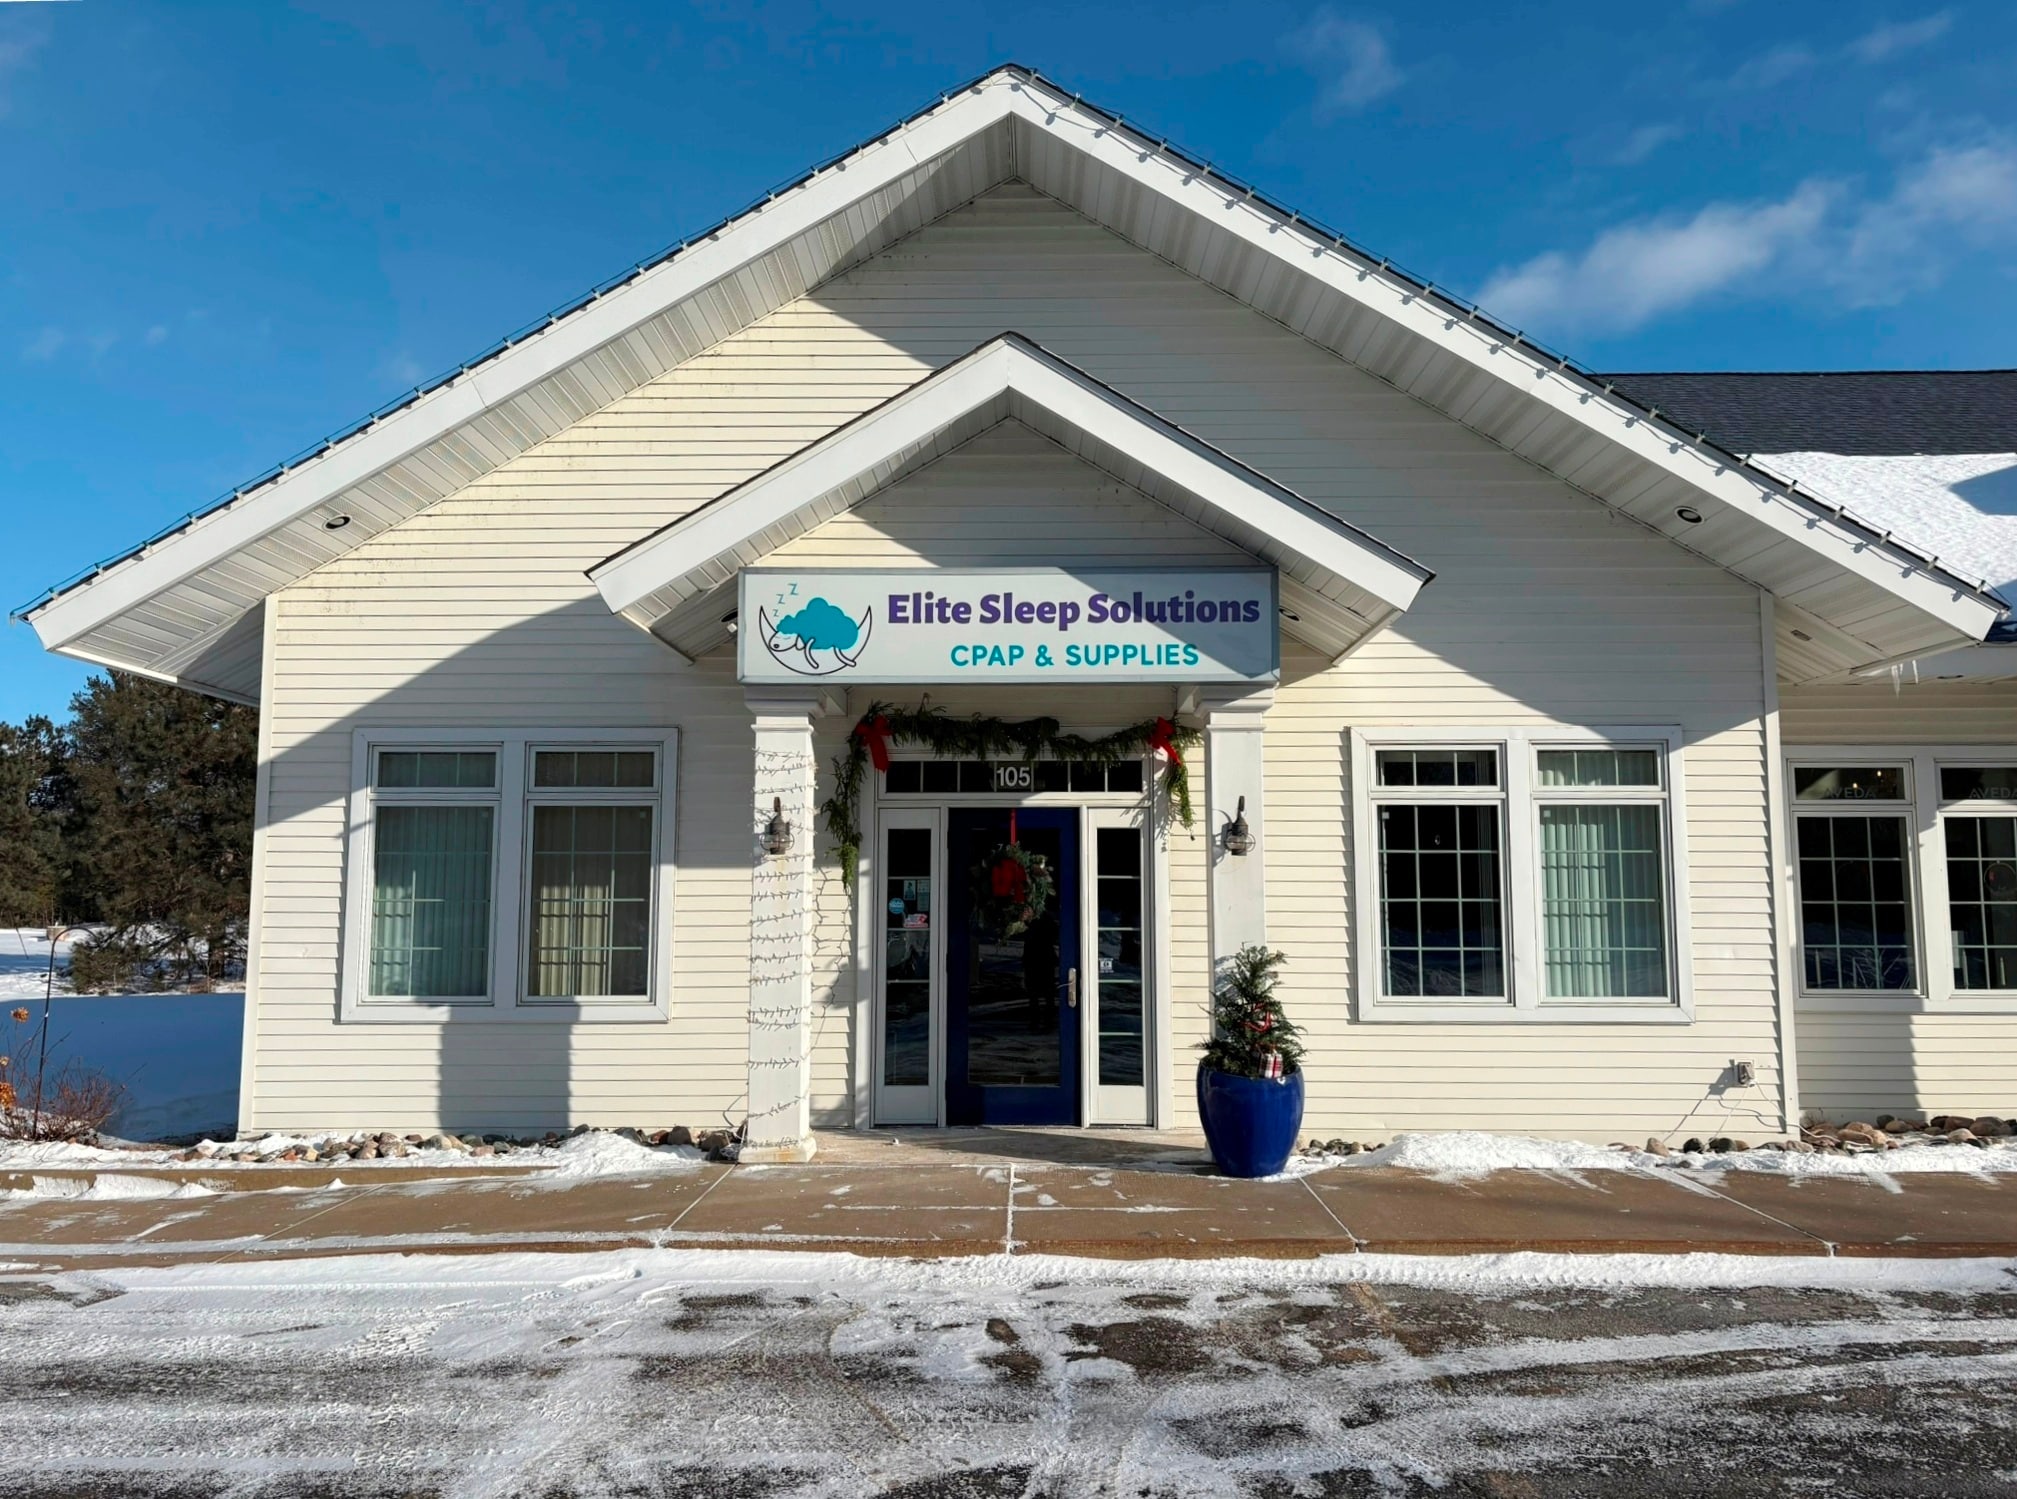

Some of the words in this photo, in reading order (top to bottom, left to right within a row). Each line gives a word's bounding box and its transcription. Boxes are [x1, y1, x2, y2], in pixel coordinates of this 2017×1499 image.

[888, 592, 971, 623] Elite
[980, 592, 1080, 631] Sleep
[1087, 590, 1260, 623] Solutions
[951, 645, 1024, 667] CPAP
[1035, 645, 1054, 667] &
[1066, 644, 1199, 666] SUPPLIES
[996, 766, 1031, 787] 105
[1824, 787, 1876, 799] AVEDA
